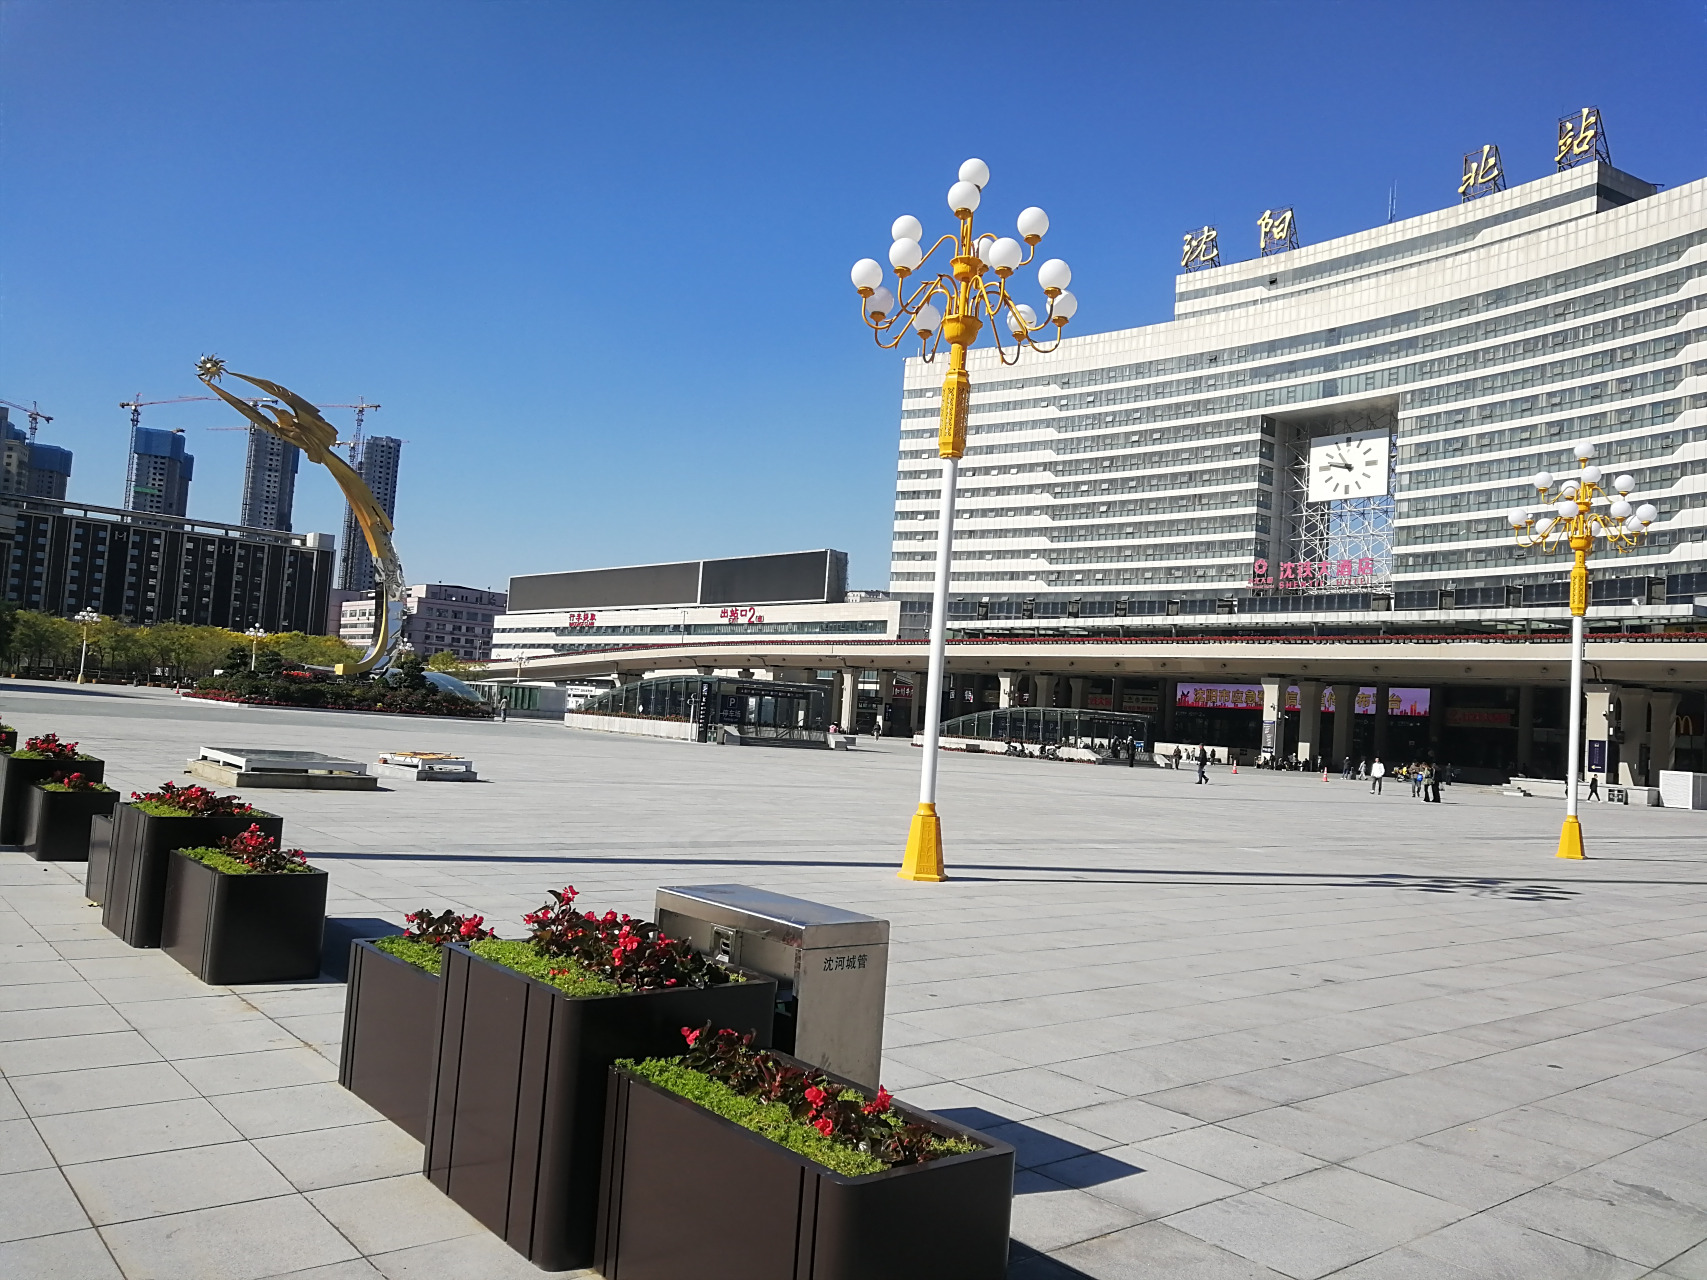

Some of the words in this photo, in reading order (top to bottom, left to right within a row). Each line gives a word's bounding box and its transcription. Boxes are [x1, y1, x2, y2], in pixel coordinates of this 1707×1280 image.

[1180, 107, 1597, 268] 沈阳北站
[1280, 557, 1375, 579] 沈铁大酒店
[823, 954, 868, 971] 沈河城管
